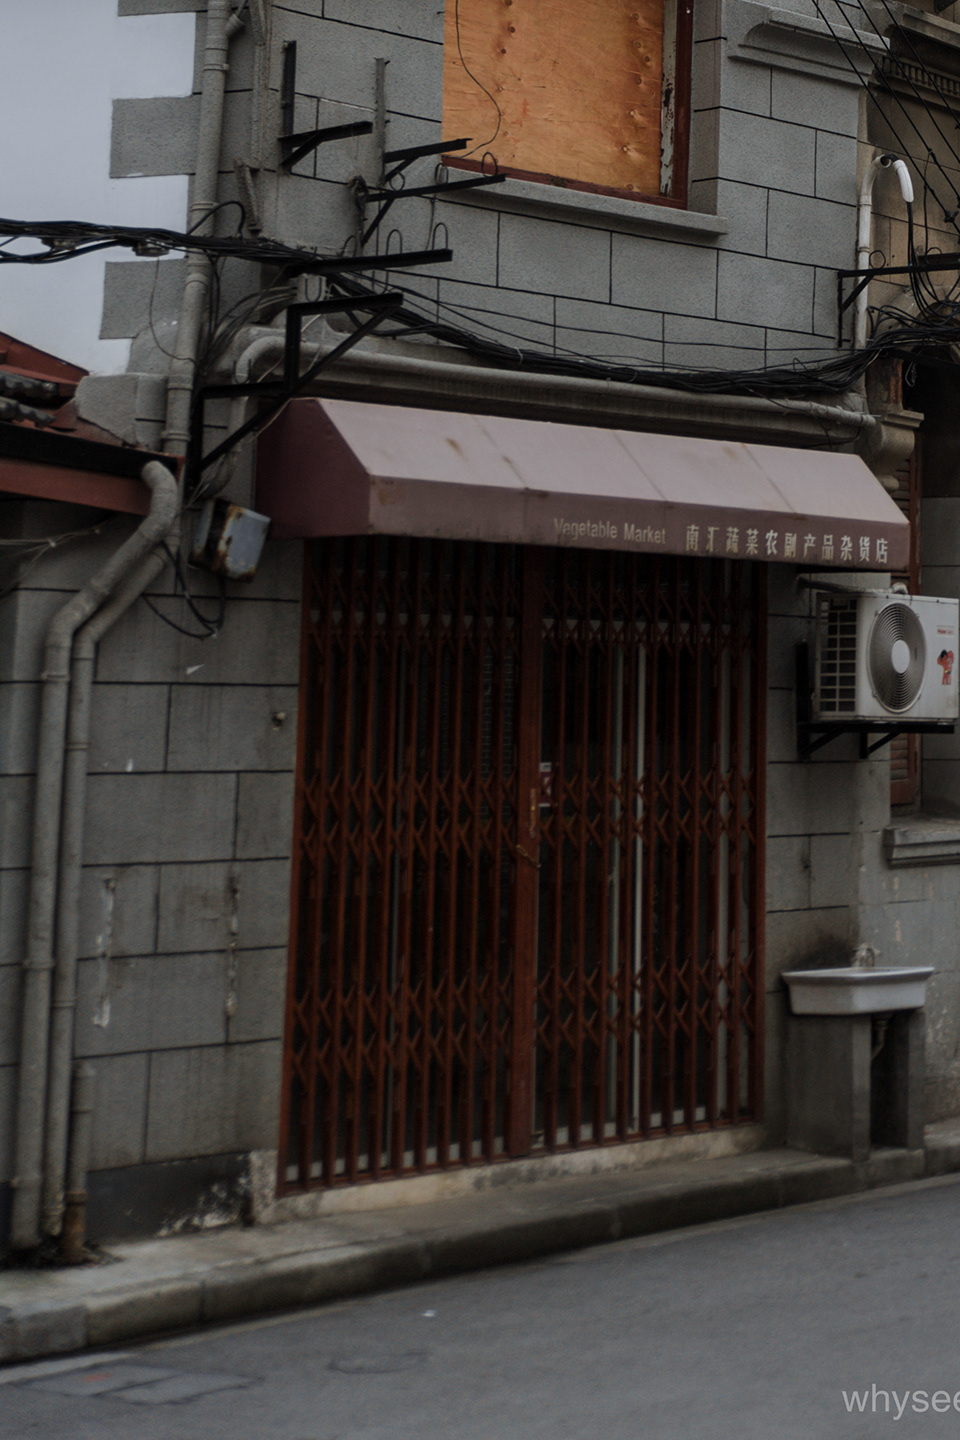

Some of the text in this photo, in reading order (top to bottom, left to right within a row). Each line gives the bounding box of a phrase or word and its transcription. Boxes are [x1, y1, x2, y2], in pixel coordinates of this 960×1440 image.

[554, 518, 666, 545] Vegetable Market
[686, 524, 888, 564] 南汇蔬菜农副产品杂货店
